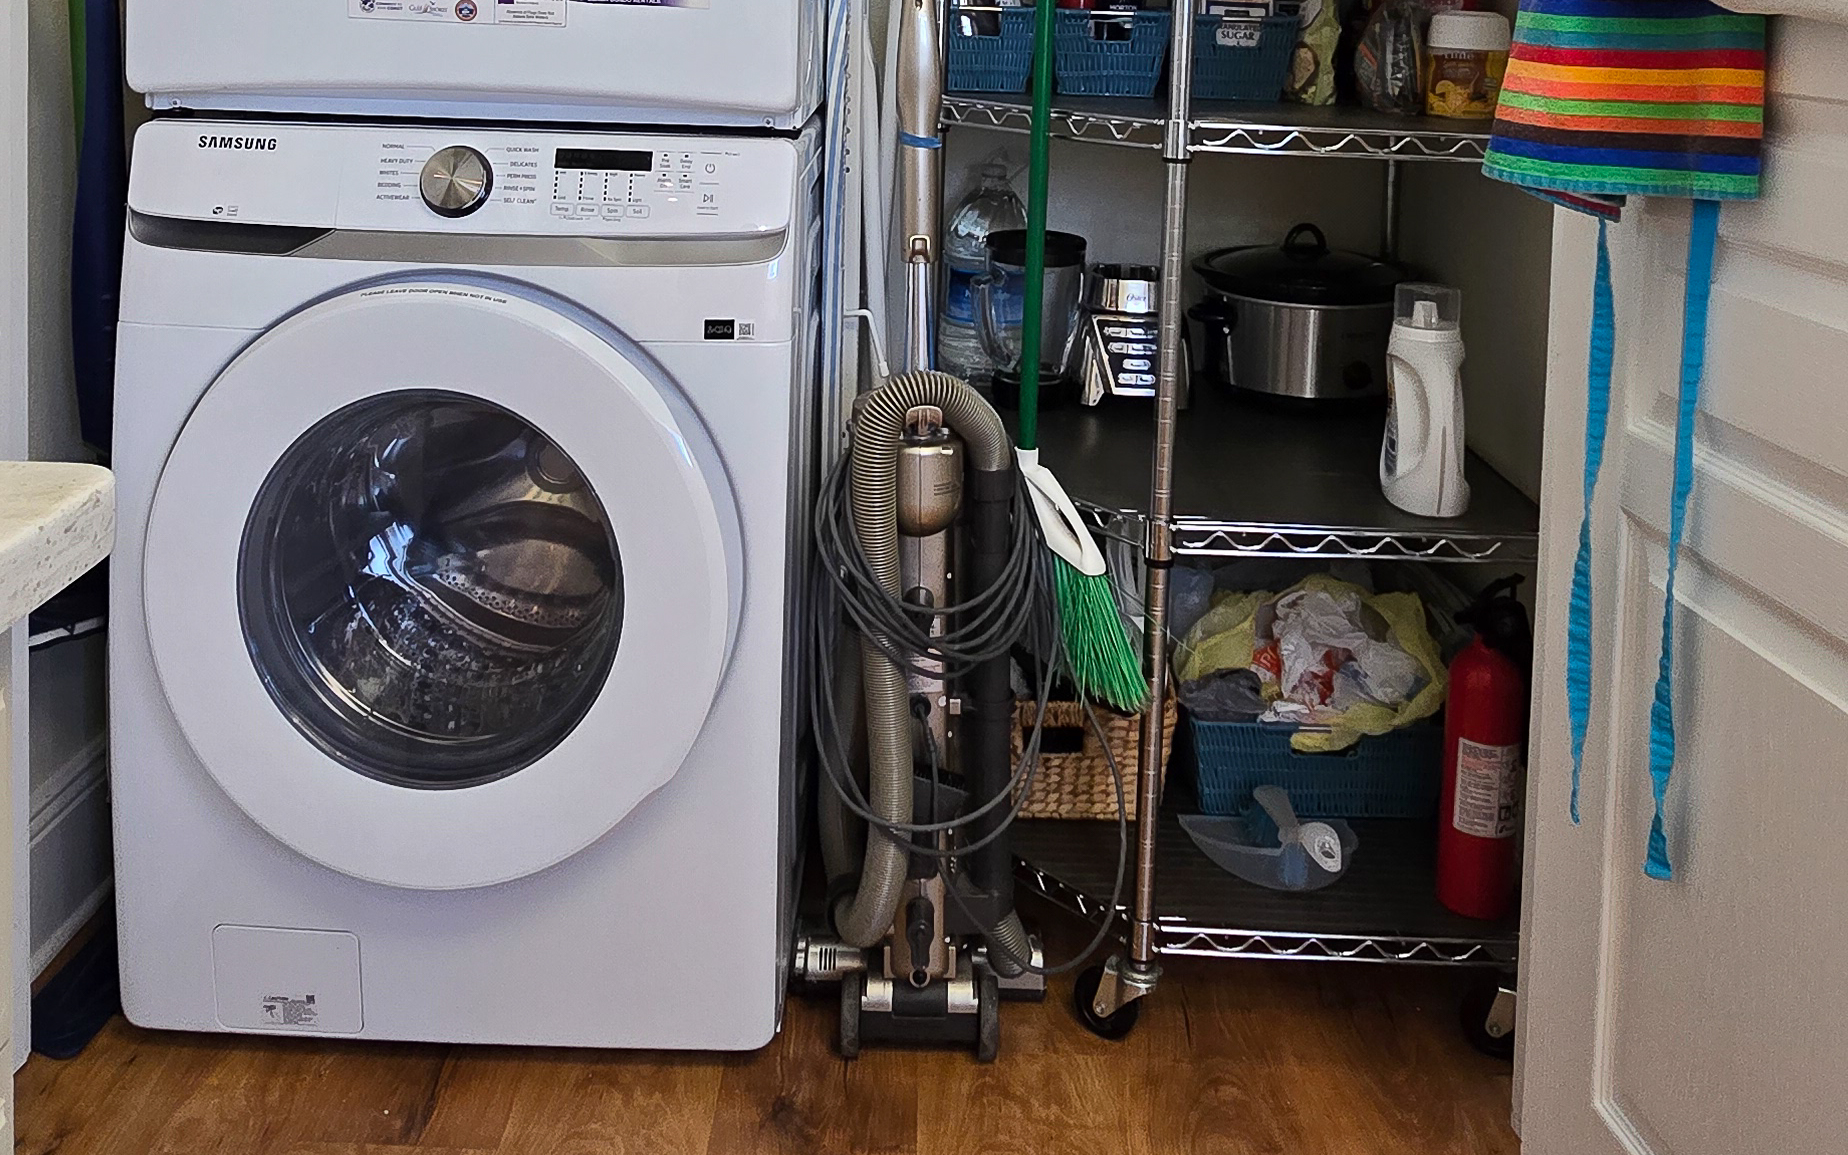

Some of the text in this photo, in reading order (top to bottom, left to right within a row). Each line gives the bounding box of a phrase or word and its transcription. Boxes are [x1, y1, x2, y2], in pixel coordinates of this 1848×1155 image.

[1220, 30, 1256, 40] SUGAR
[198, 135, 277, 151] SAMSUNG
[360, 289, 385, 297] PLEASE
[492, 296, 508, 304] USE
